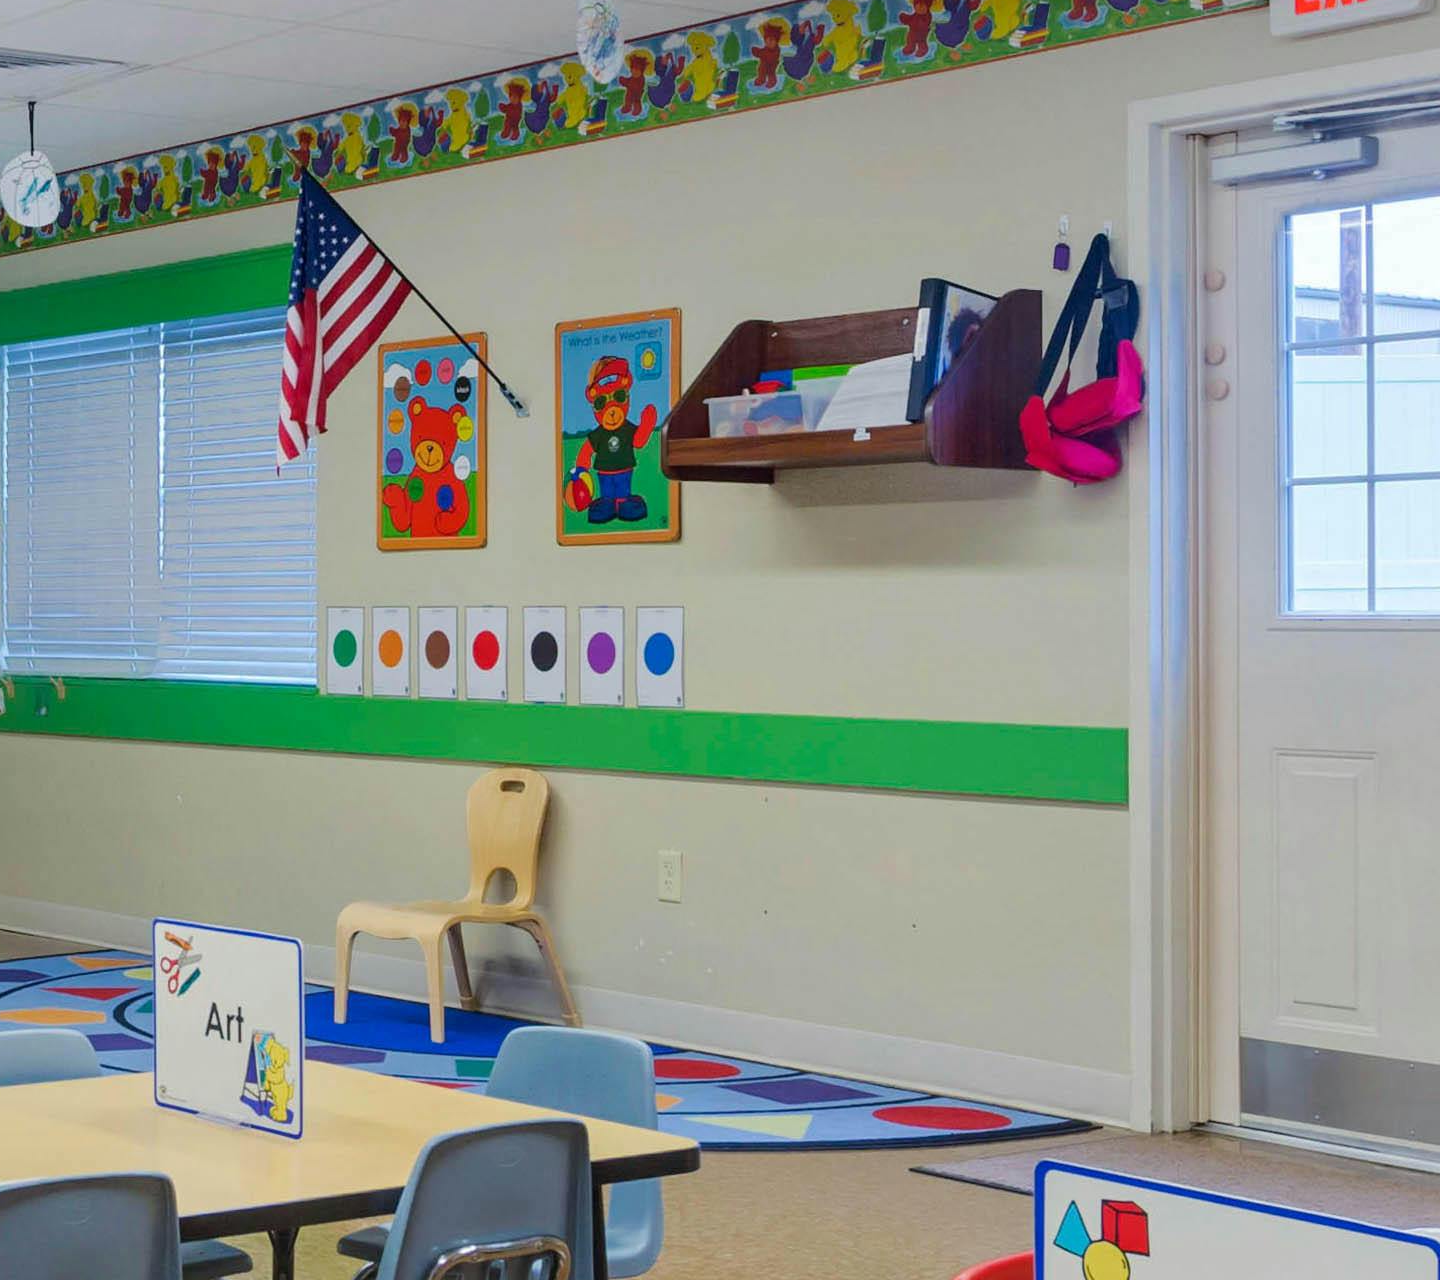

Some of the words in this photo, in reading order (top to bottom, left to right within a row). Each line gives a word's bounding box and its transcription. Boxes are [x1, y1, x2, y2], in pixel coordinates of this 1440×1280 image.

[568, 334, 593, 347] What
[602, 333, 617, 345] the
[619, 326, 664, 343] Weather?
[205, 1002, 244, 1043] Art
